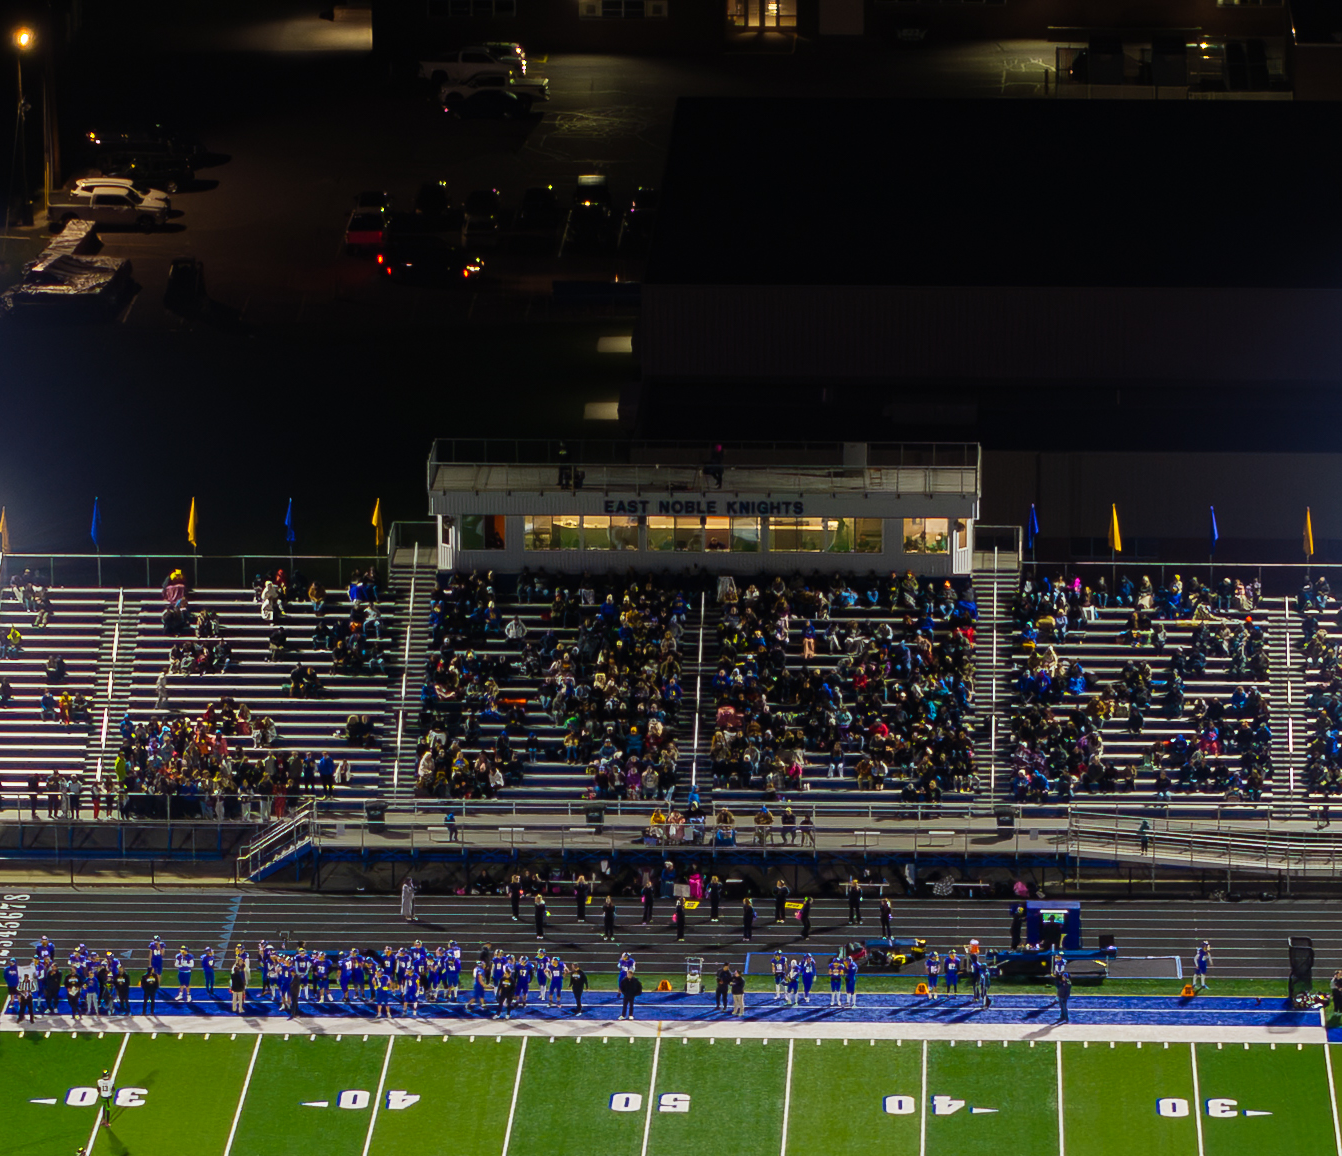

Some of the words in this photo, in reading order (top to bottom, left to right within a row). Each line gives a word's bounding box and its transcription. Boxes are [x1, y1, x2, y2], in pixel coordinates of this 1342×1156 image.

[603, 500, 650, 515] EAST
[658, 500, 717, 515] NOBLE
[725, 500, 805, 516] KNIGHTS
[3, 893, 31, 901] 8
[337, 1089, 421, 1111] 40
[608, 1092, 691, 1113] 50
[883, 1095, 966, 1116] 40
[1155, 1097, 1239, 1118] 30
